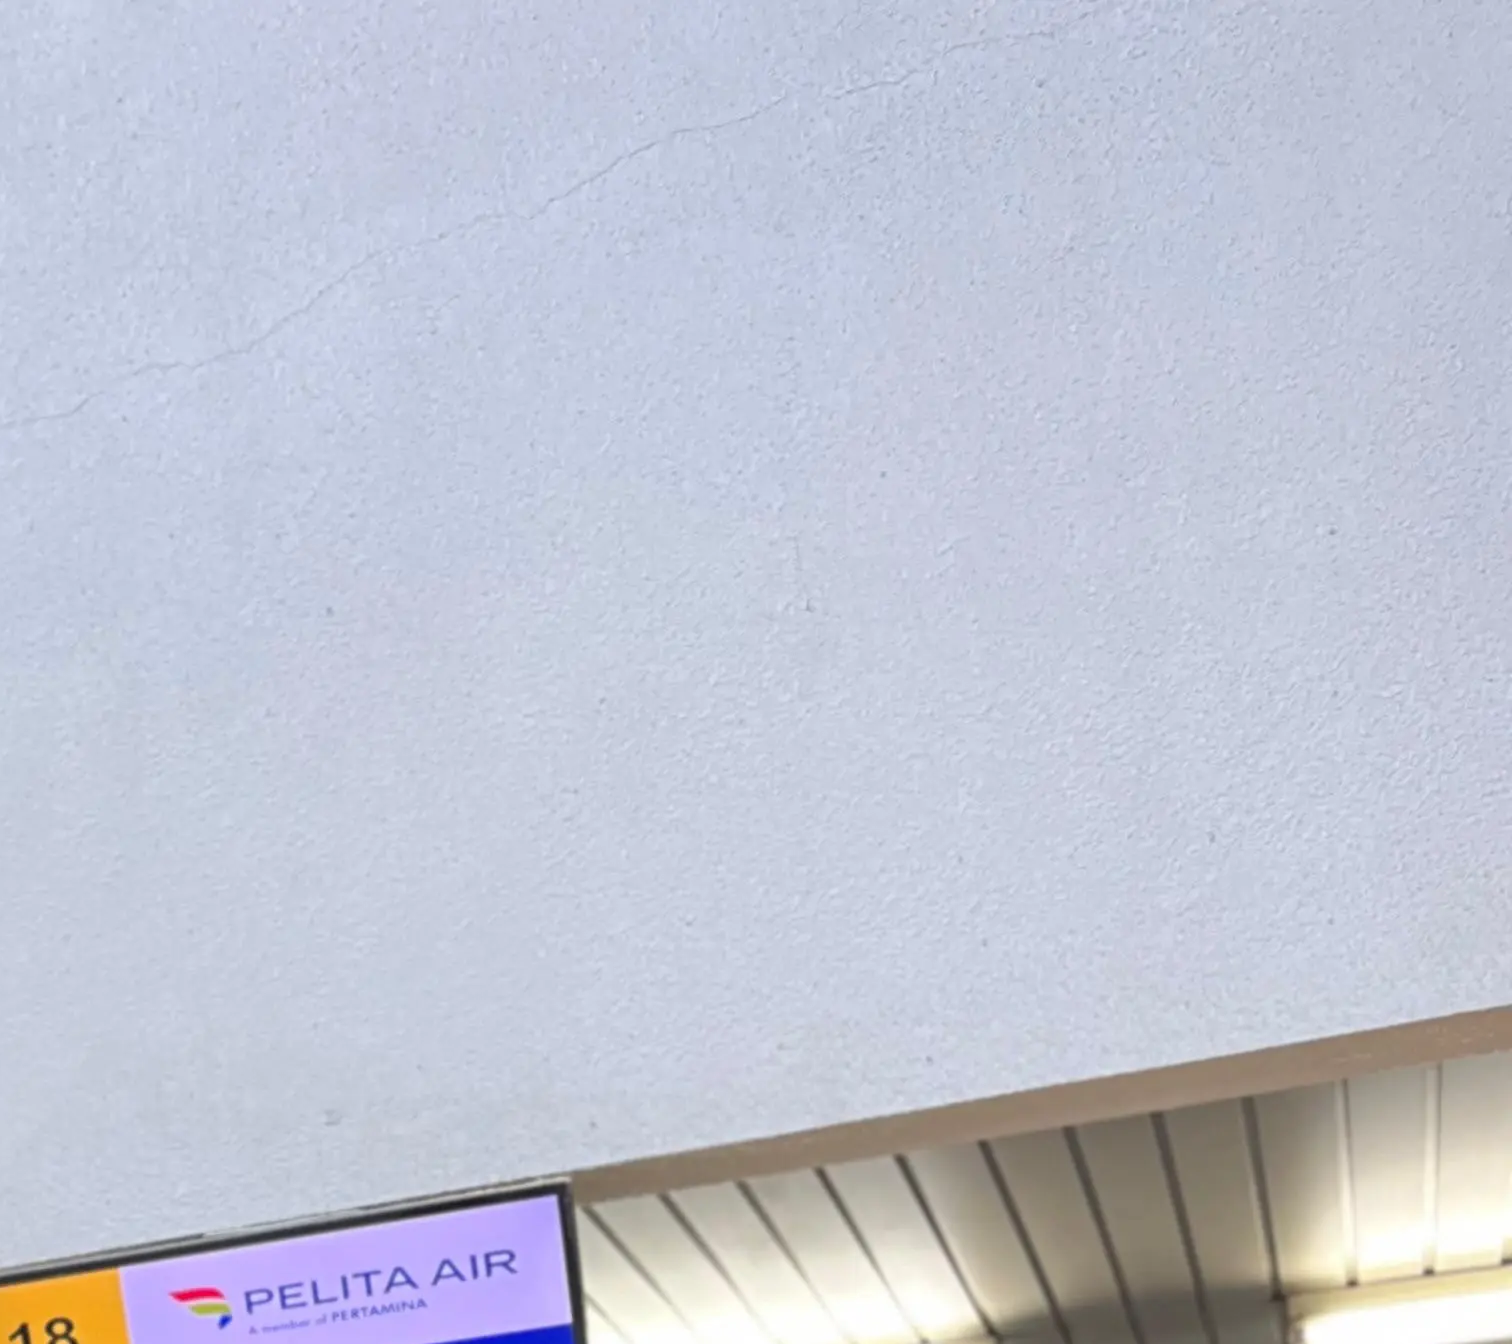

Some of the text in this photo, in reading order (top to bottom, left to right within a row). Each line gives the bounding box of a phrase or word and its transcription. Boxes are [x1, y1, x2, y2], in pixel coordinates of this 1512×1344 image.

[244, 1249, 518, 1315] PELITA AIR
[332, 1297, 429, 1323] PERTAMINA
